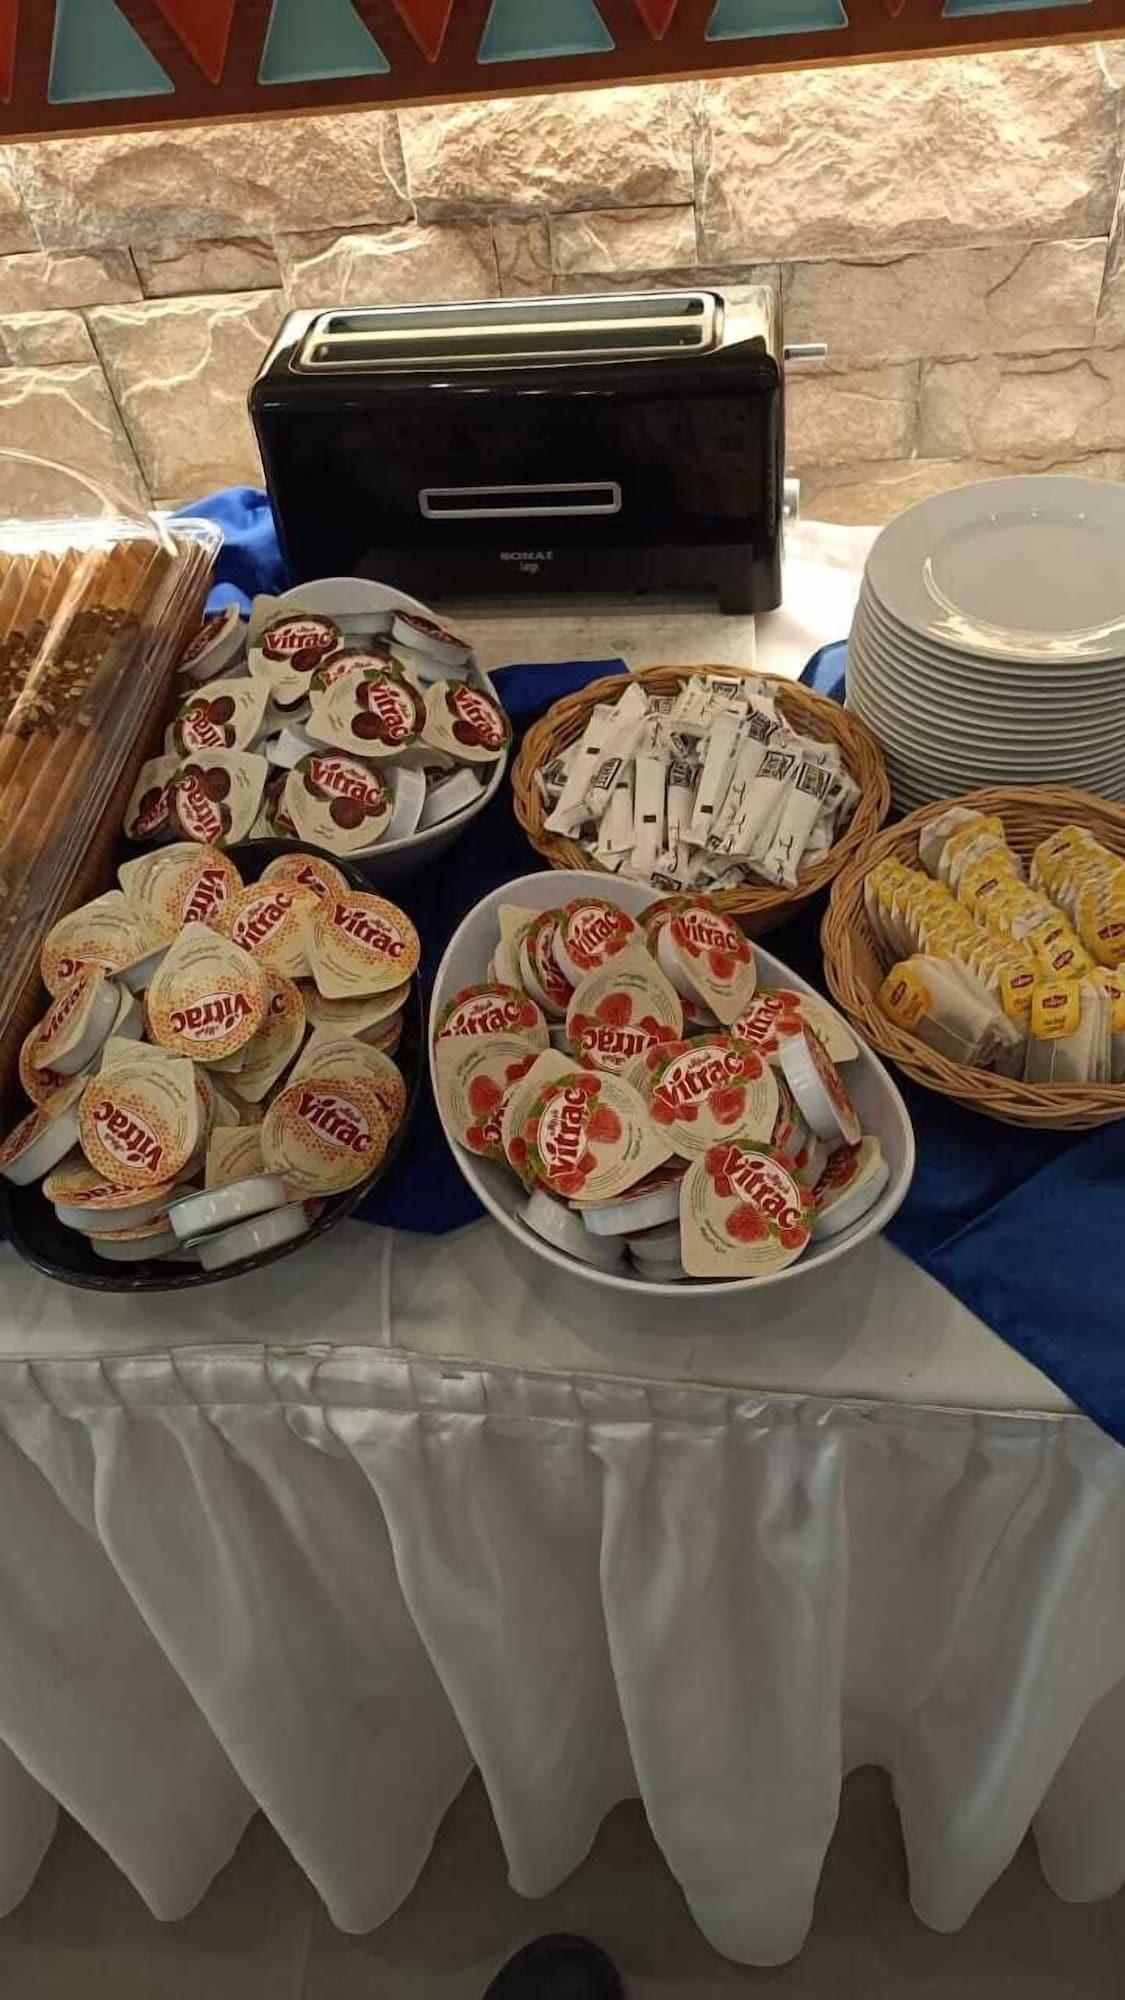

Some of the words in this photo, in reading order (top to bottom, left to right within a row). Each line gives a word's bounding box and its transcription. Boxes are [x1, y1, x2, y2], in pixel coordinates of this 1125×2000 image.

[266, 627, 333, 650] Vitrac
[186, 709, 227, 749] itrac
[369, 678, 410, 739] Vitrac
[454, 685, 504, 744] Vitrac
[310, 757, 383, 806] Vitrac
[181, 776, 222, 844] Vitrac
[184, 869, 226, 924] Vitra
[332, 903, 407, 958] Vitrac
[568, 910, 619, 954] Vitrac
[678, 915, 739, 951] Vitrac
[171, 993, 253, 1034] Vitrac
[654, 1052, 743, 1107] Vitrac
[93, 1101, 165, 1173] Vitrac
[299, 1092, 371, 1153] Vitrac
[546, 1087, 588, 1178] Vitrac
[724, 1146, 801, 1229] Vitrac
